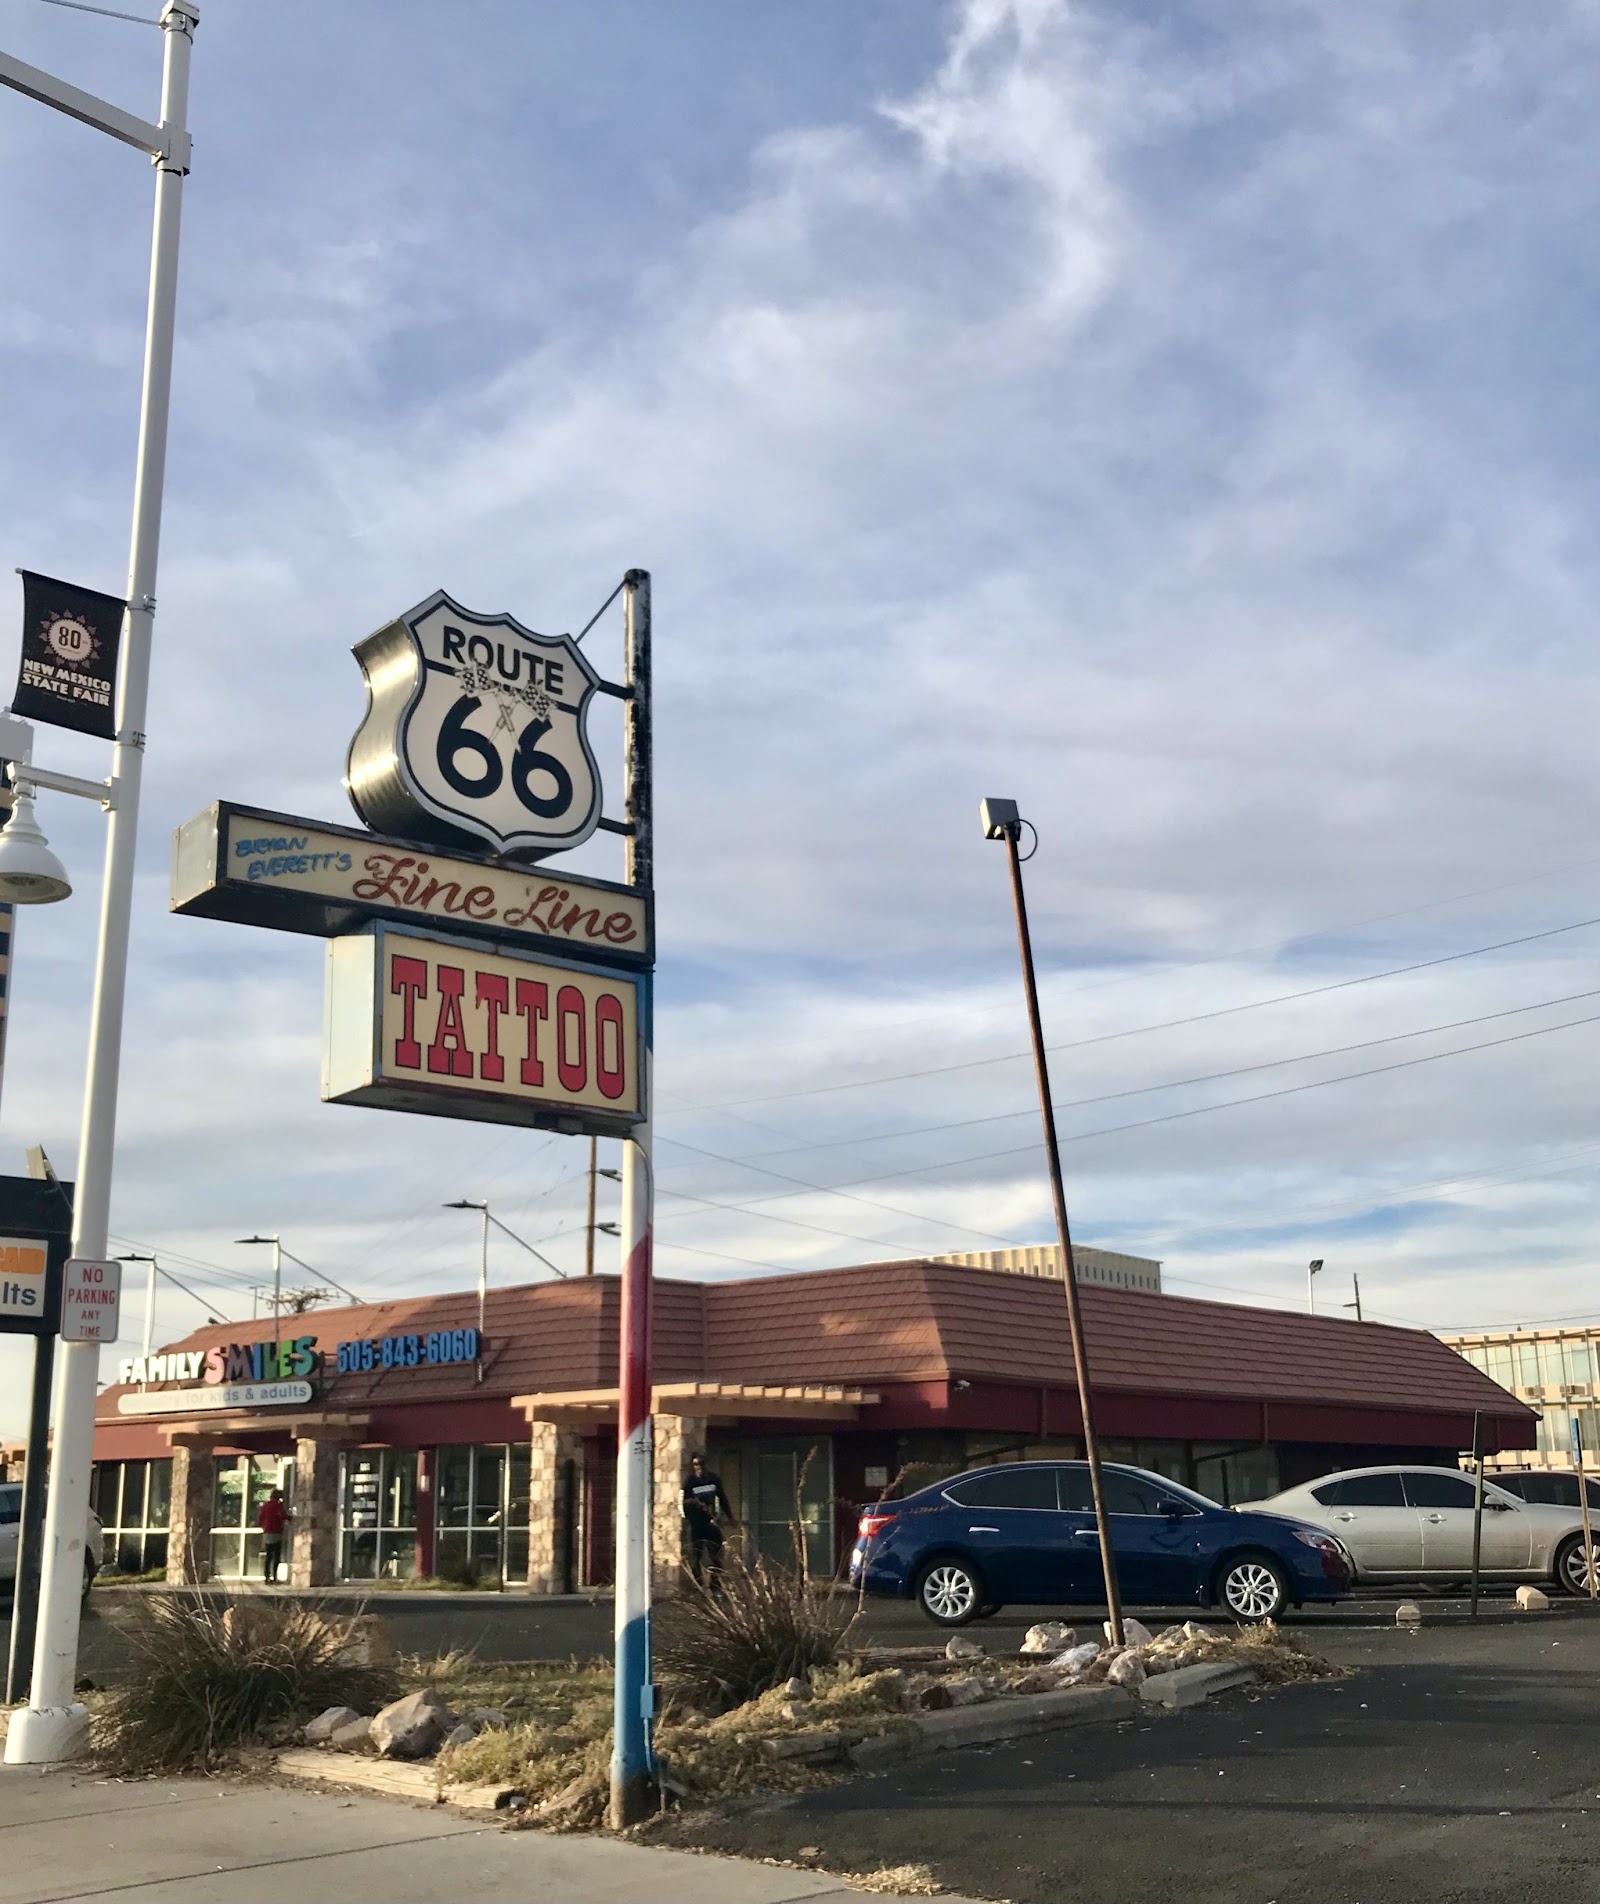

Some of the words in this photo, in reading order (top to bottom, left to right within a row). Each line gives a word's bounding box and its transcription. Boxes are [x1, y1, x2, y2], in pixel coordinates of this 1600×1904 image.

[58, 626, 81, 649] 80
[24, 659, 55, 676] NEW
[56, 668, 111, 692] MEXICO
[443, 625, 564, 695] ROUTE
[22, 673, 68, 695] STATE
[73, 686, 110, 706] FAIR
[436, 693, 573, 819] 66
[248, 851, 352, 880] EVERETT'S
[352, 854, 498, 921] Fine
[503, 886, 637, 943] Line
[391, 953, 625, 1100] TATTOO
[82, 1267, 104, 1283] NO
[68, 1288, 116, 1305] PARKING
[81, 1310, 101, 1321] ANY
[79, 1326, 101, 1338] TIME
[336, 1327, 477, 1373] 505-843-6060
[209, 1388, 239, 1402] kids
[245, 1387, 254, 1400] &
[260, 1384, 307, 1399] adults
